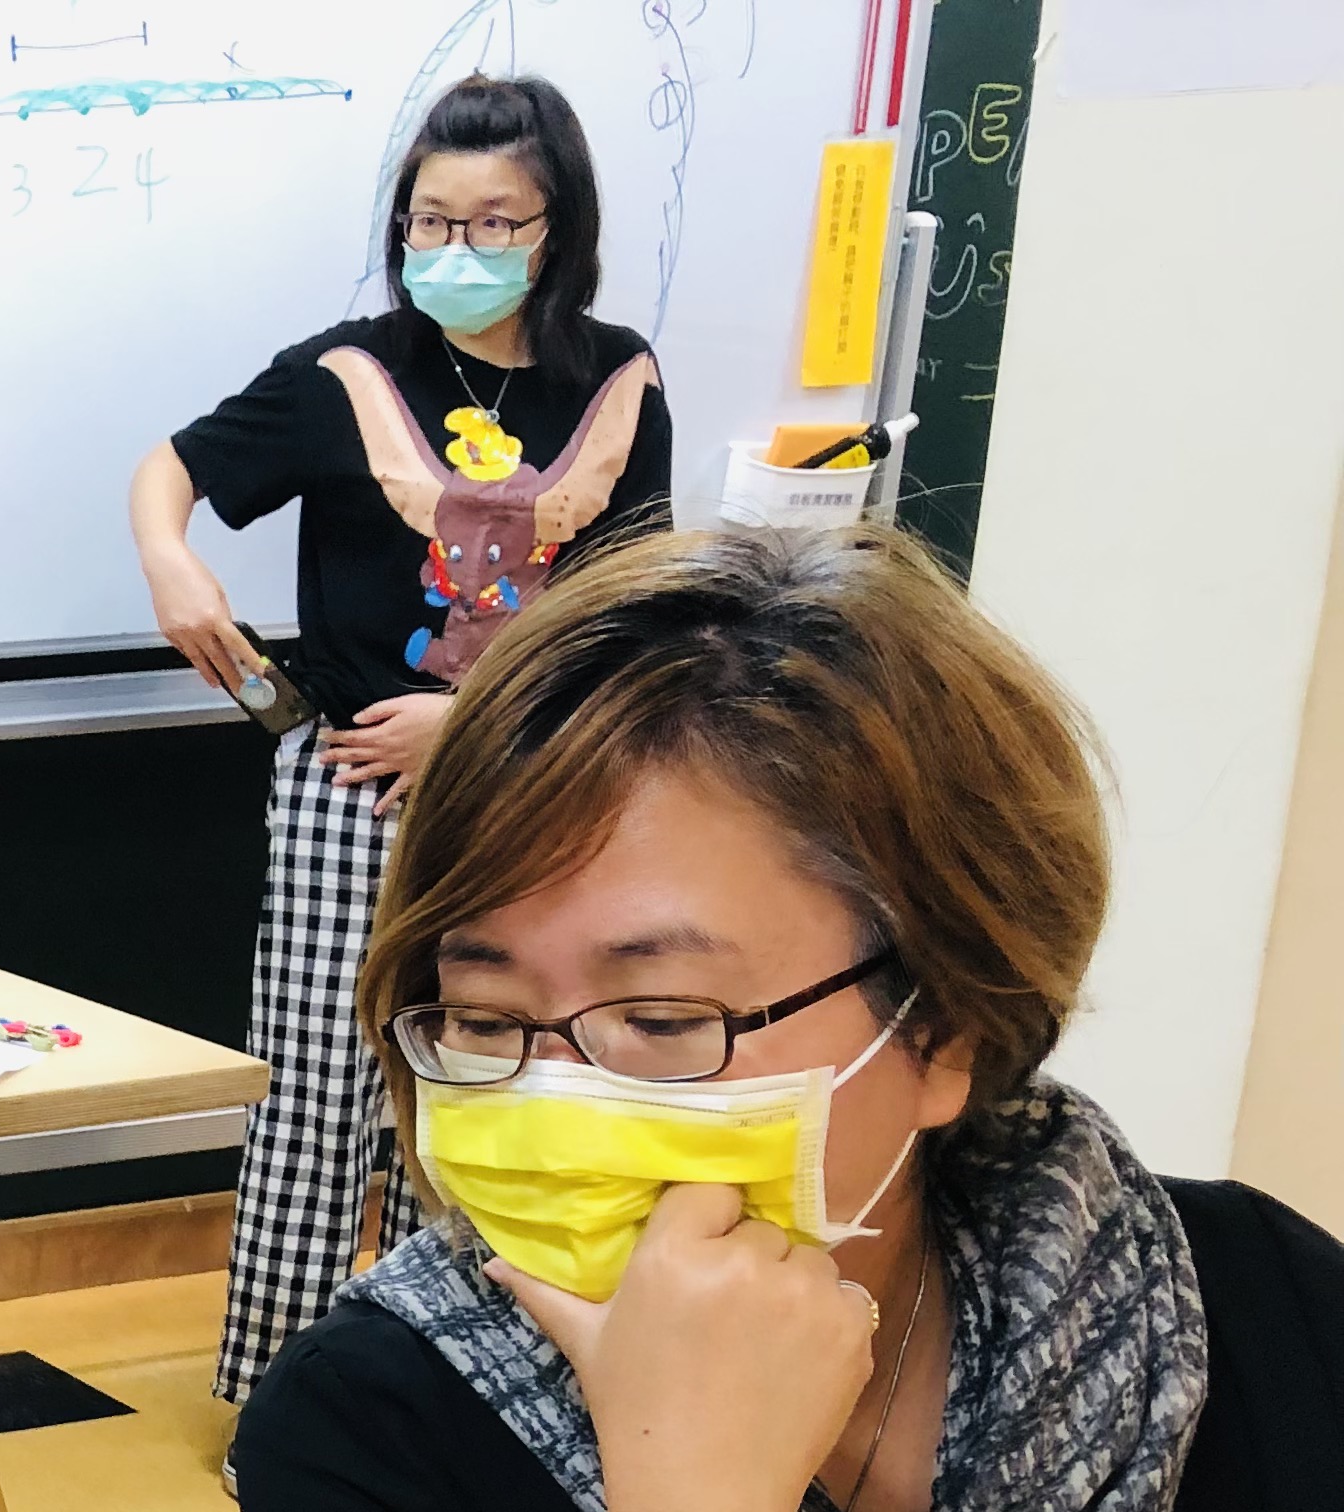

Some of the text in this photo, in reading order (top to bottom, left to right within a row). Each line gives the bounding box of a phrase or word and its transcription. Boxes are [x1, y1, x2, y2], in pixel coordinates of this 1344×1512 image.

[11, 163, 33, 217] 3
[72, 144, 119, 197] 2
[136, 146, 170, 224] 4
